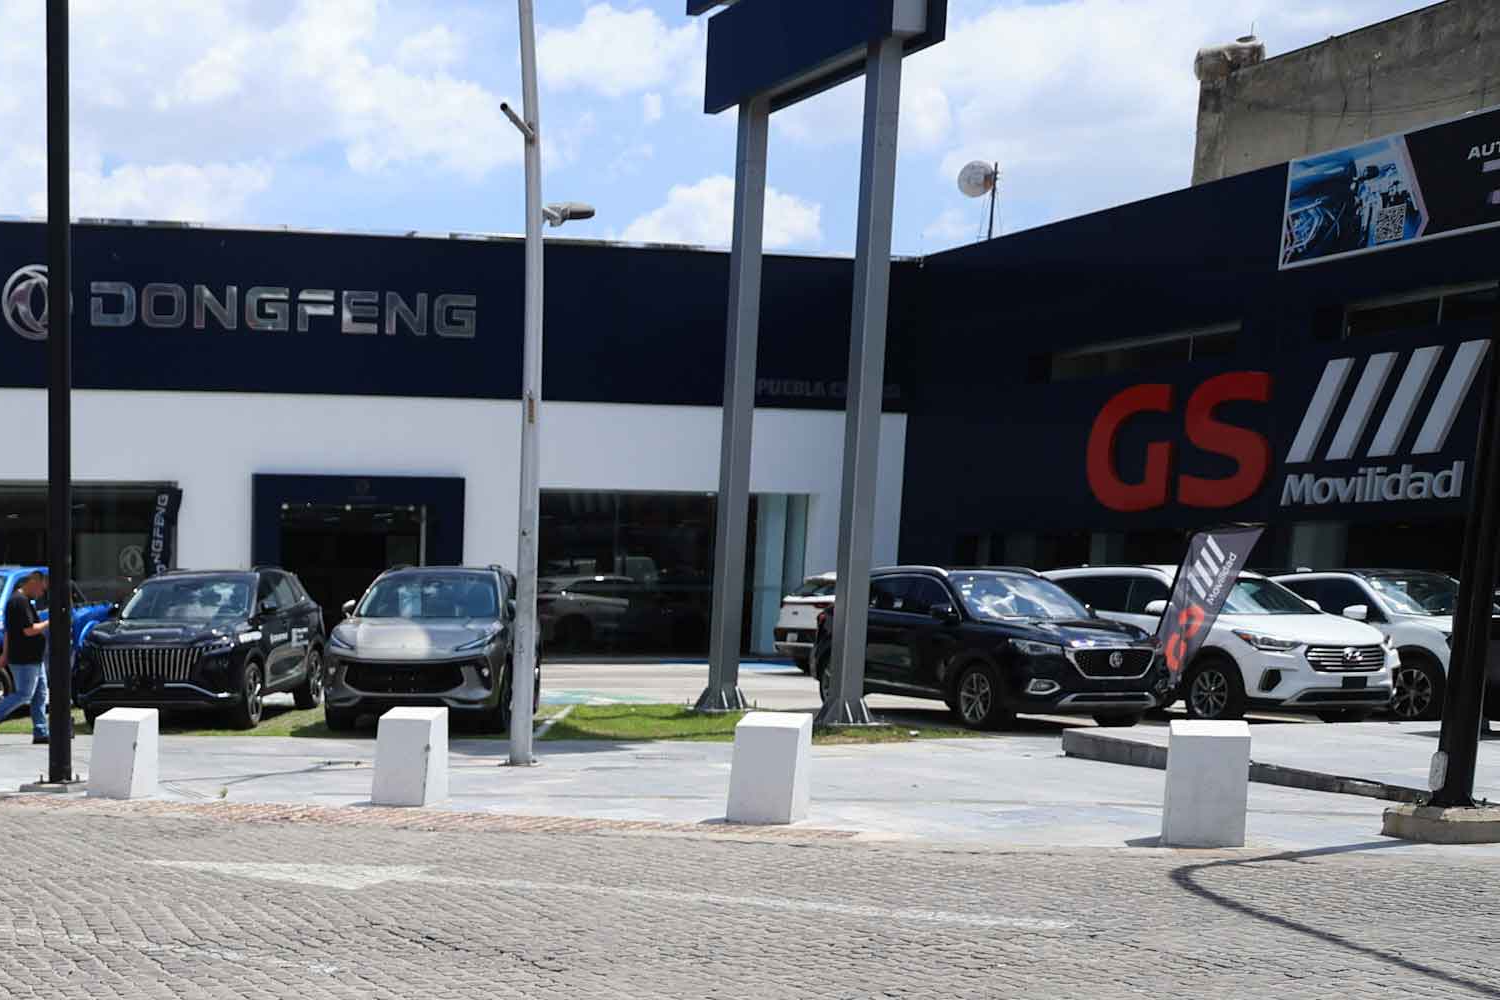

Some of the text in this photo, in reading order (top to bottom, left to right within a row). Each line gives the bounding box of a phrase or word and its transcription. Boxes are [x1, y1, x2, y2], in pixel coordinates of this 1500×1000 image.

[90, 281, 477, 338] DONGFENG
[1086, 371, 1273, 512] GS
[1279, 460, 1466, 507] Movilidad
[150, 494, 169, 576] ONGFENG
